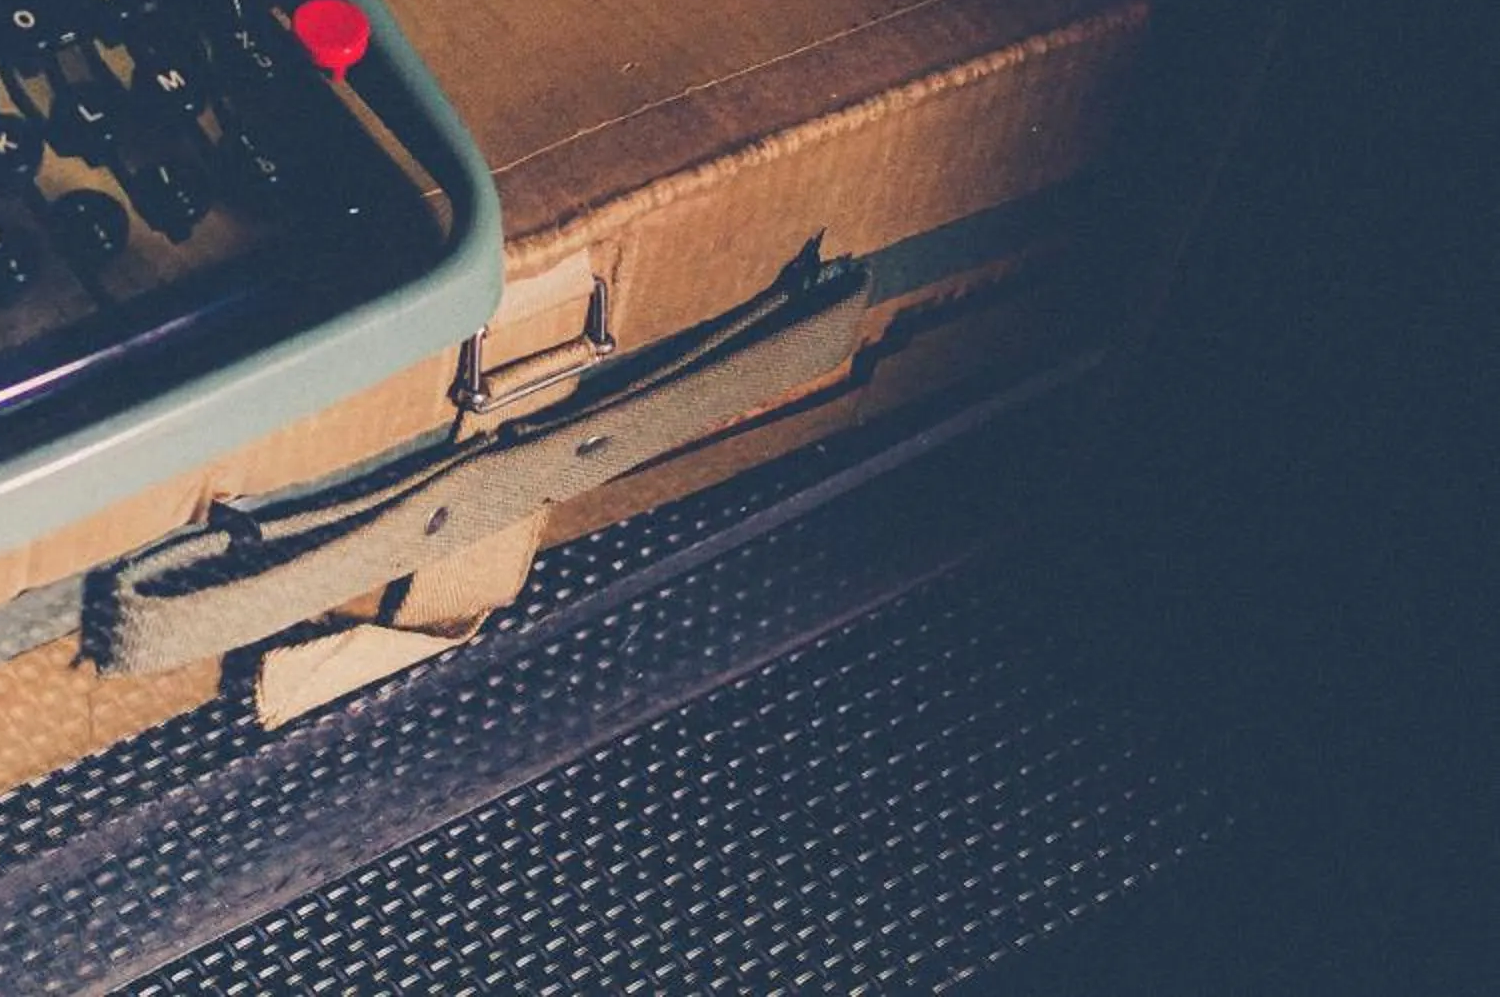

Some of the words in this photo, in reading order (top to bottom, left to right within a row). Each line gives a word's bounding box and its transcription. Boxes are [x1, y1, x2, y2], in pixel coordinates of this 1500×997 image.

[14, 11, 35, 27] O
[79, 106, 103, 121] L
[157, 71, 185, 91] M
